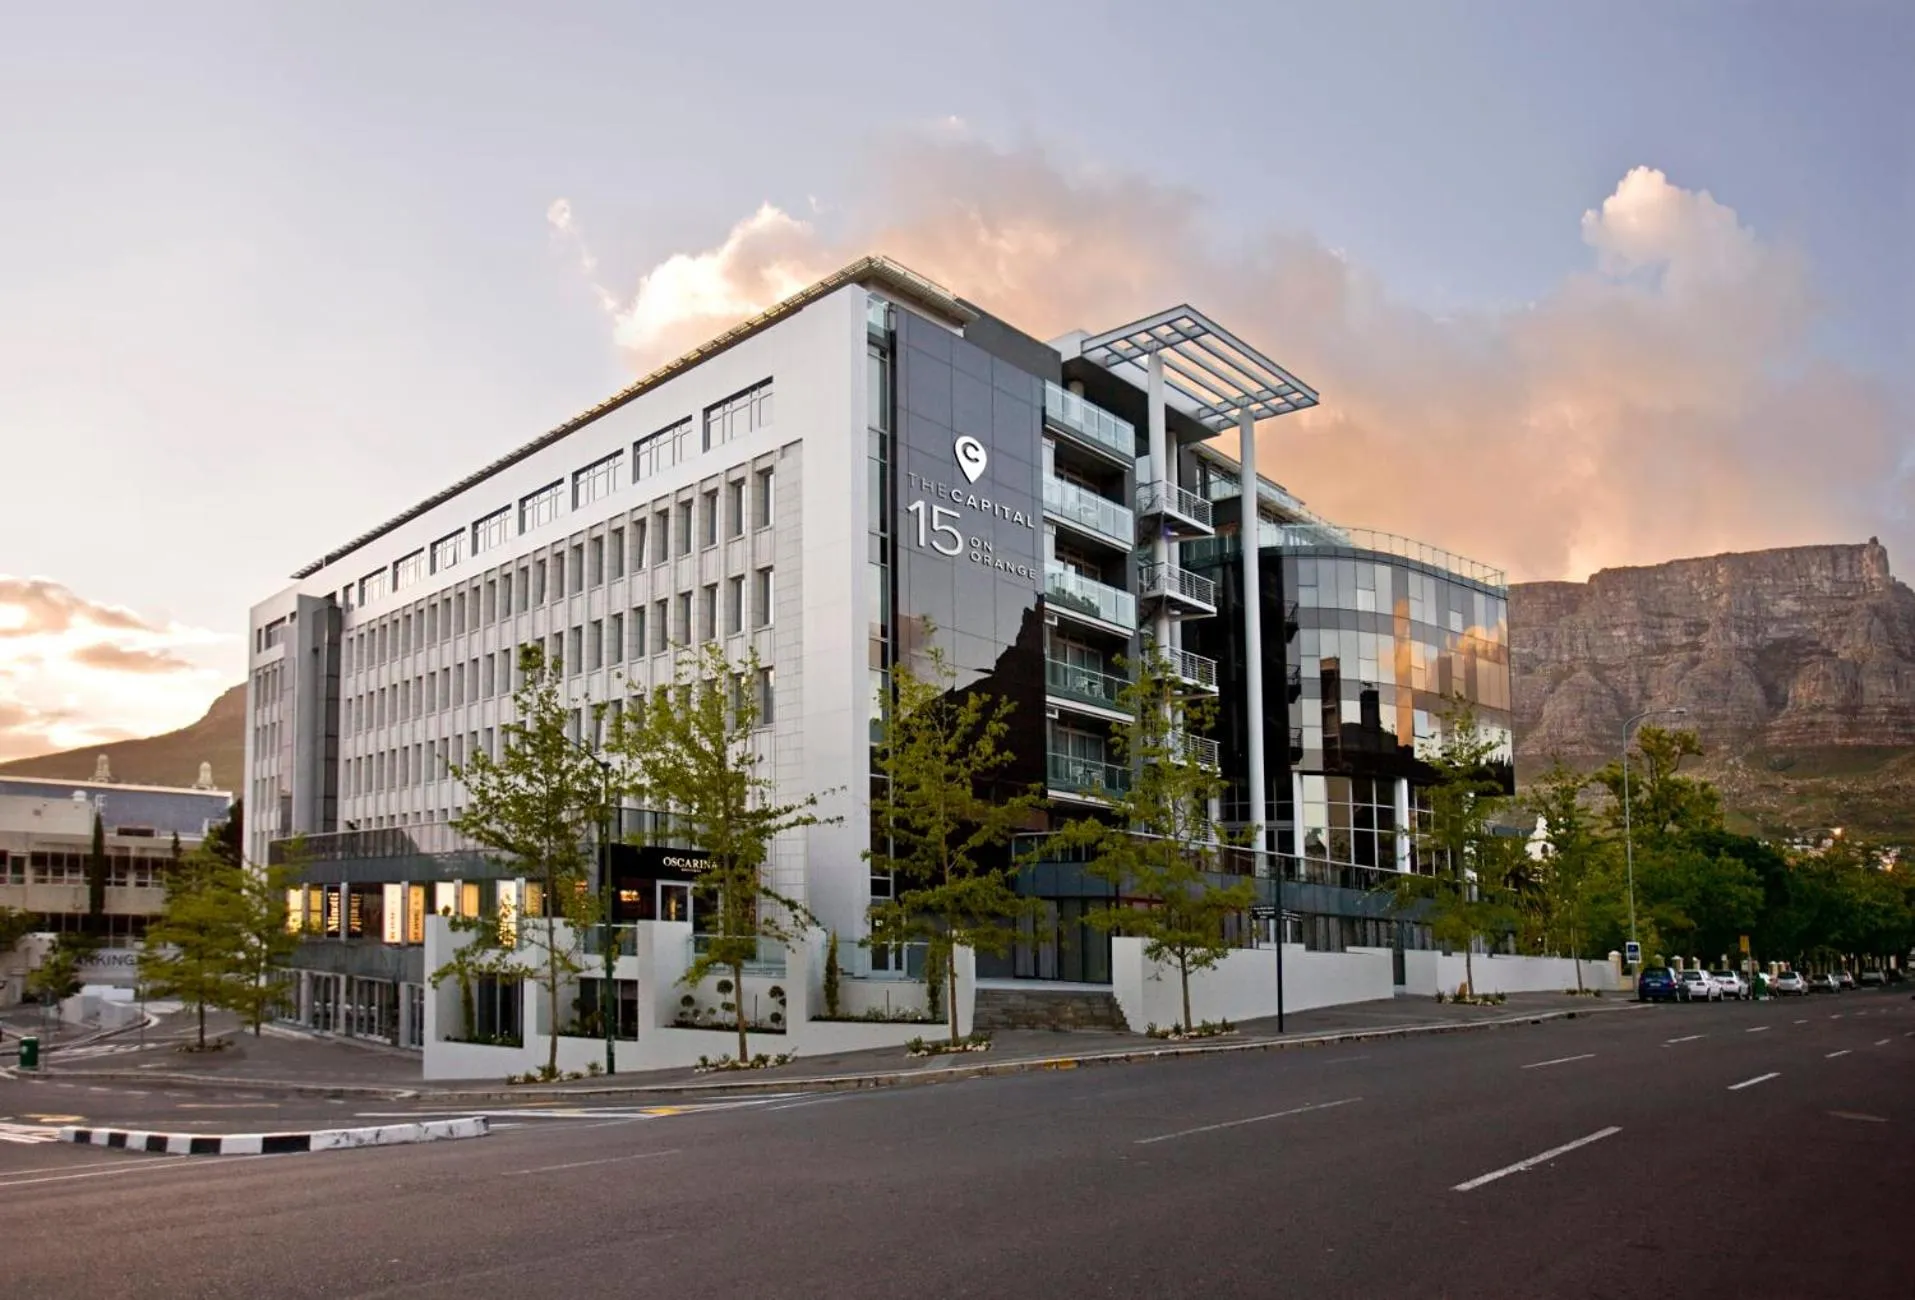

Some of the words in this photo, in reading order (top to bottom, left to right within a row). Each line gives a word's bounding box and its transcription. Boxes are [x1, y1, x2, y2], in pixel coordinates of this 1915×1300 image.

[907, 500, 964, 556] 15
[970, 535, 993, 552] ON
[970, 551, 1037, 580] ORANGE
[74, 953, 137, 968] ARKING
